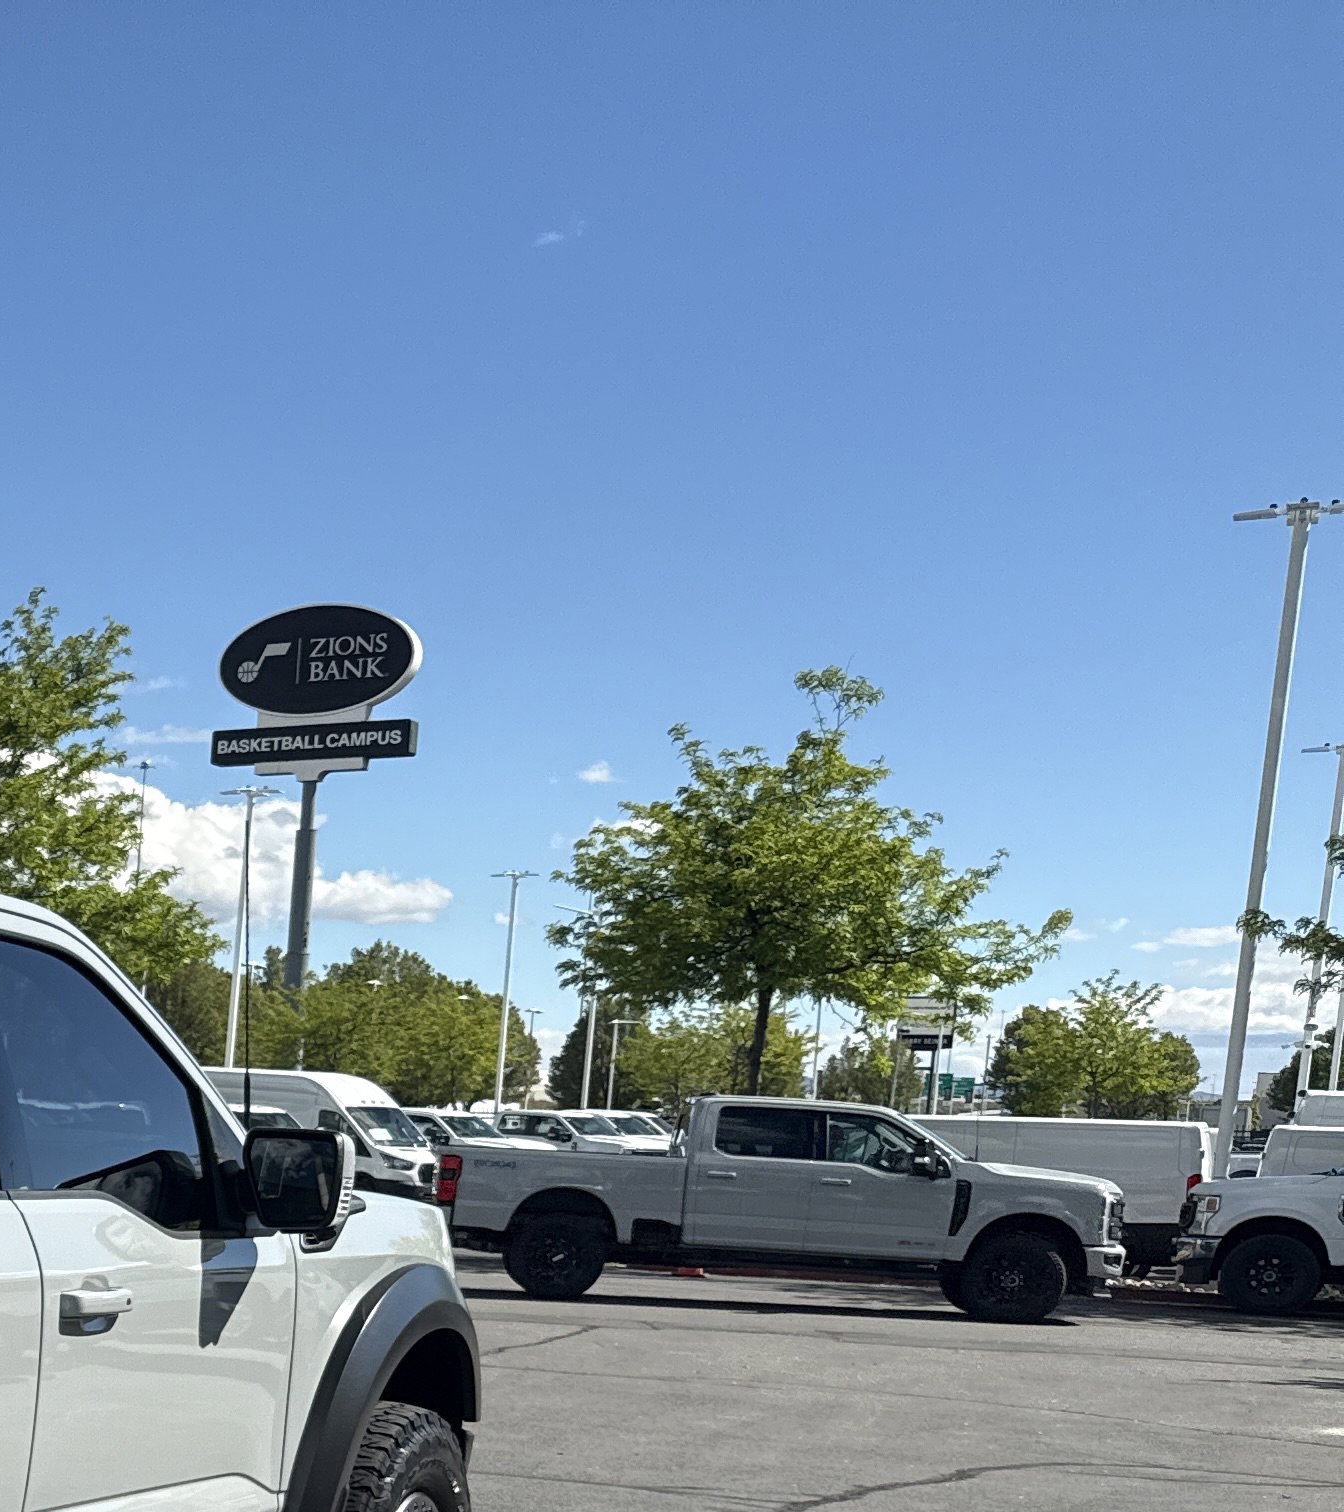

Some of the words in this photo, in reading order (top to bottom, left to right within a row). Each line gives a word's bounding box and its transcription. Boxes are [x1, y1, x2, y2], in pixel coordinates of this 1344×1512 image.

[309, 633, 388, 658] ZIONS
[308, 657, 386, 682] BANK
[217, 734, 325, 755] BASKETBALL
[326, 730, 402, 748] CAMPUS
